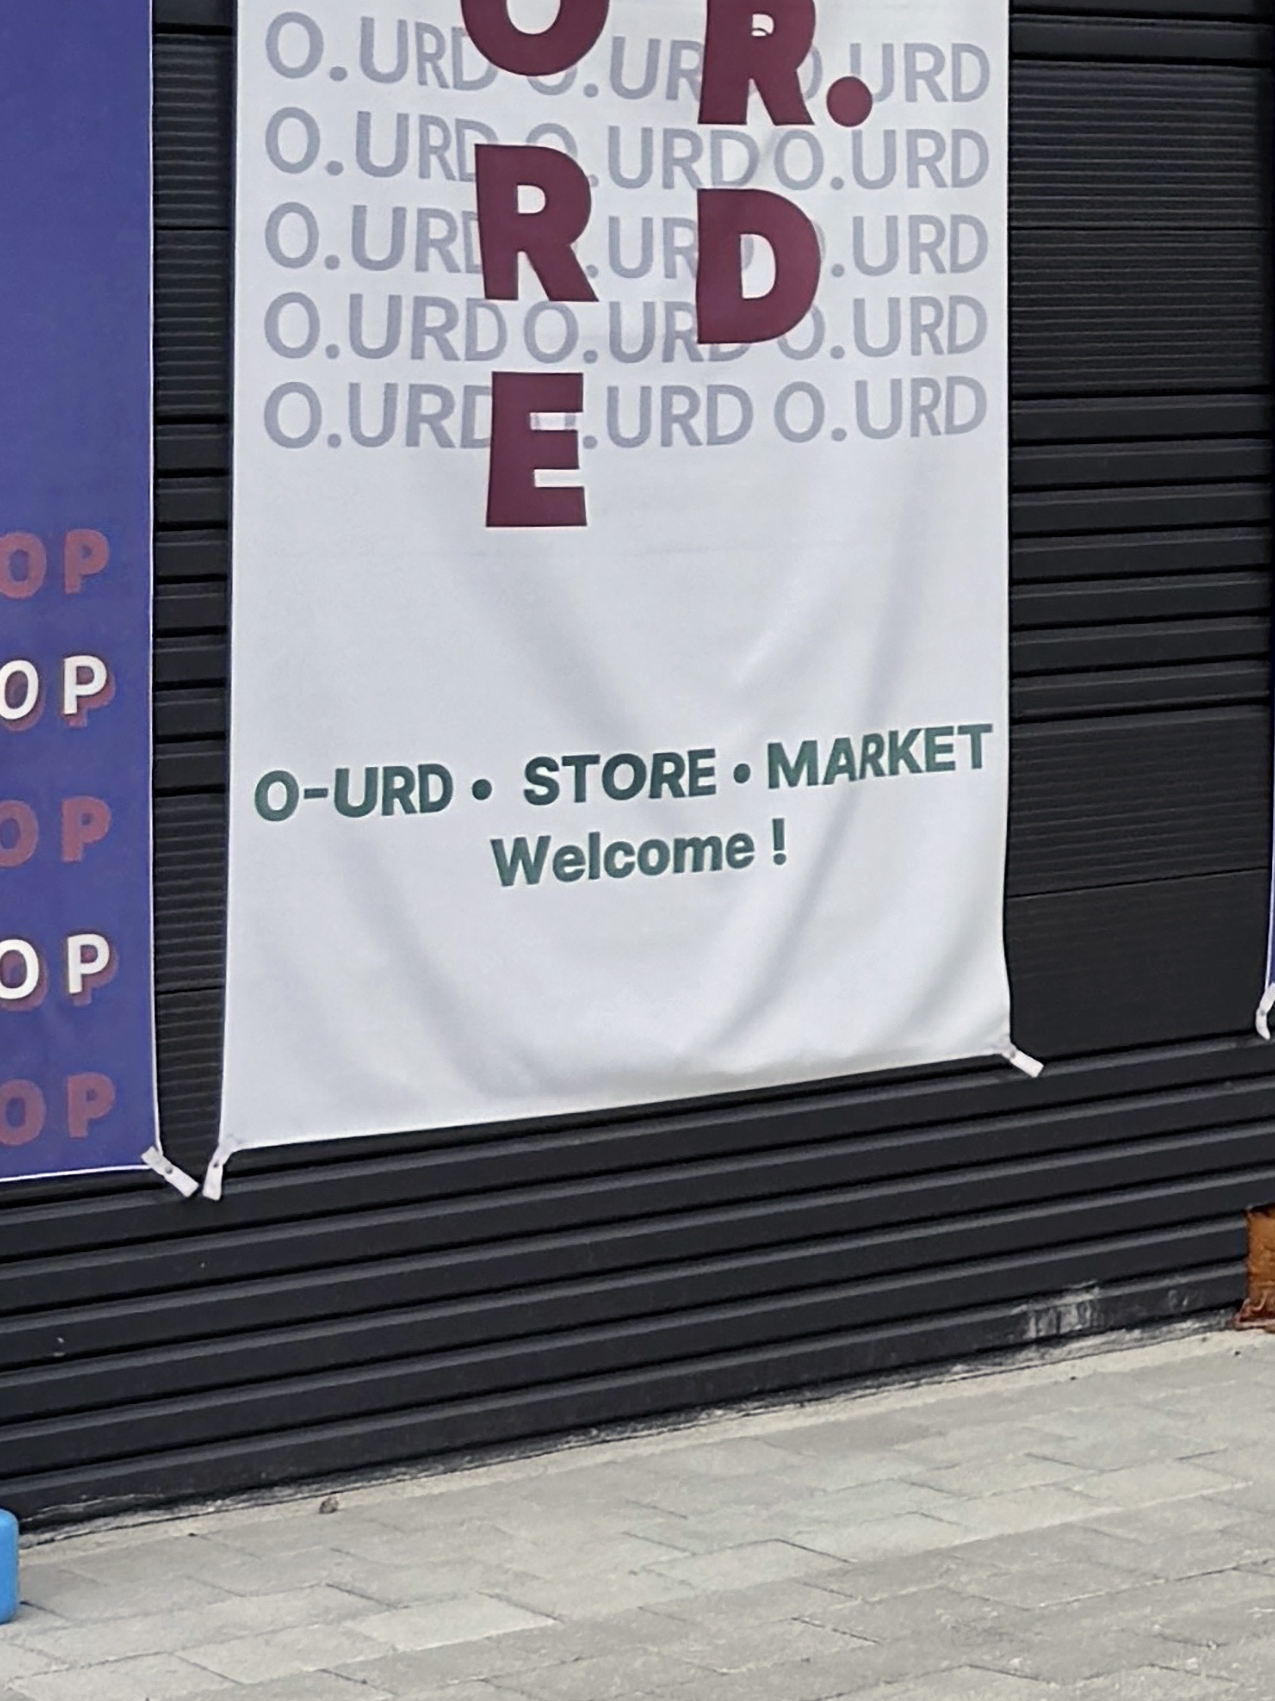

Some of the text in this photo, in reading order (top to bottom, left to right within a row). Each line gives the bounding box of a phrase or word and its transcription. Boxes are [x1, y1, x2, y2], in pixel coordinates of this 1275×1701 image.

[774, 128, 990, 191] O.URD
[814, 213, 989, 277] .URD
[264, 291, 508, 362] O.URD
[531, 383, 754, 449] .URD
[773, 375, 988, 444] O.URD
[254, 723, 994, 823] O-URD STORE MARKET
[490, 830, 755, 888] Welcome
